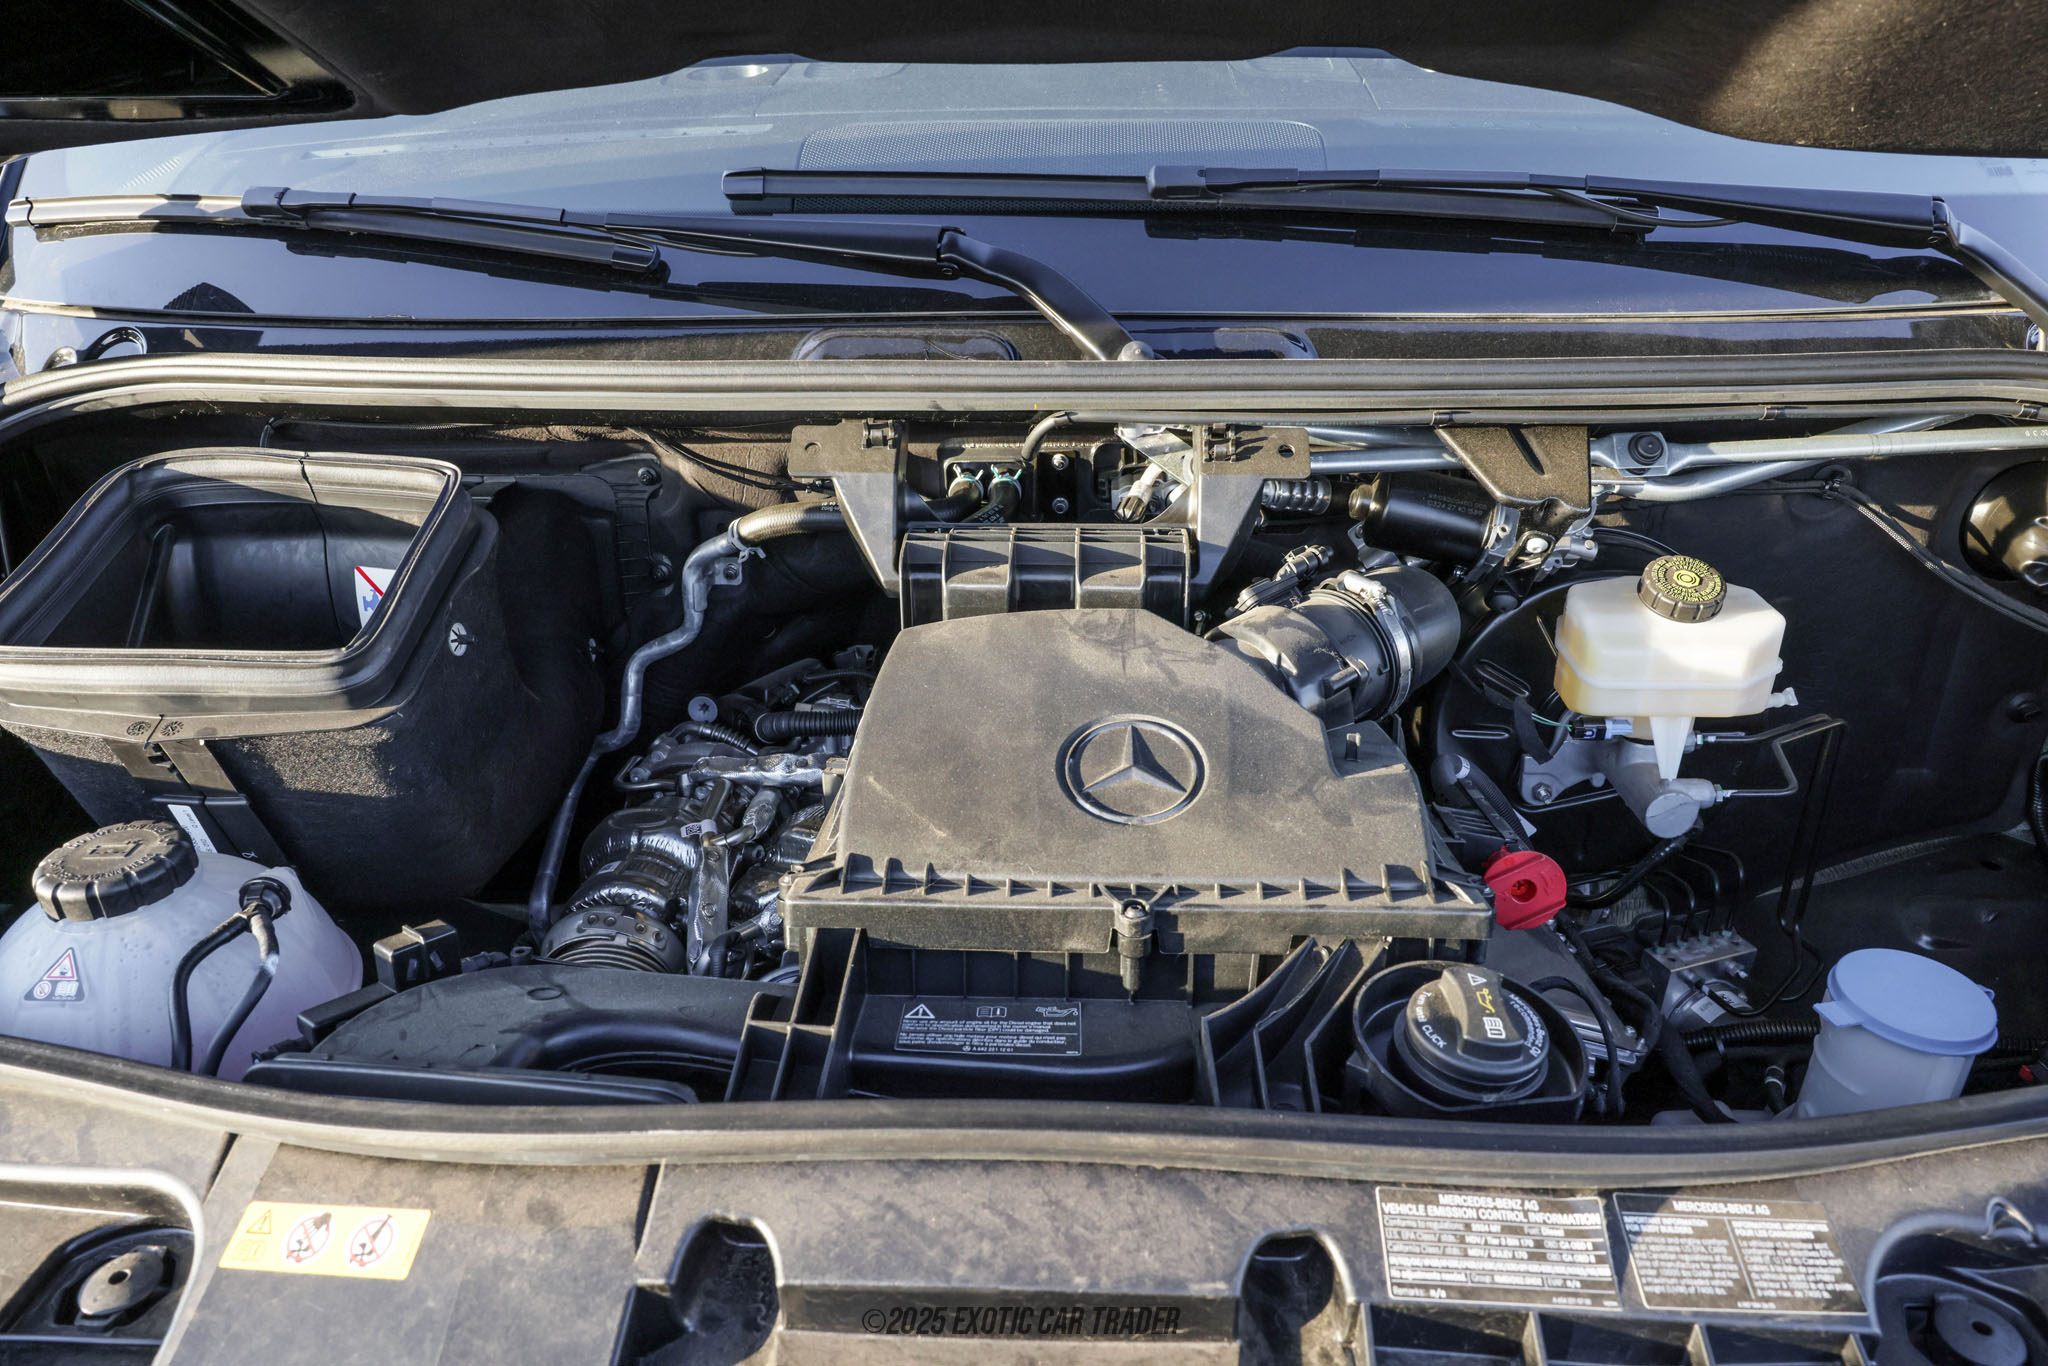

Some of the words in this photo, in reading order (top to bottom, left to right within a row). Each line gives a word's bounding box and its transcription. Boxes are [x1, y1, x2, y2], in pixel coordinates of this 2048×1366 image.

[1422, 1024, 1447, 1048] CLICK
[1438, 1194, 1523, 1210] MERCEDES-BENZ
[1524, 1200, 1539, 1211] AG
[1672, 1200, 1755, 1215] MERCEDES-BENZ
[1755, 1204, 1771, 1215] AG
[1382, 1202, 1426, 1216] VEHICLE
[1427, 1205, 1478, 1219] EMISSION
[1478, 1208, 1528, 1222] CONTROL
[1528, 1212, 1601, 1225] INFORMATION
